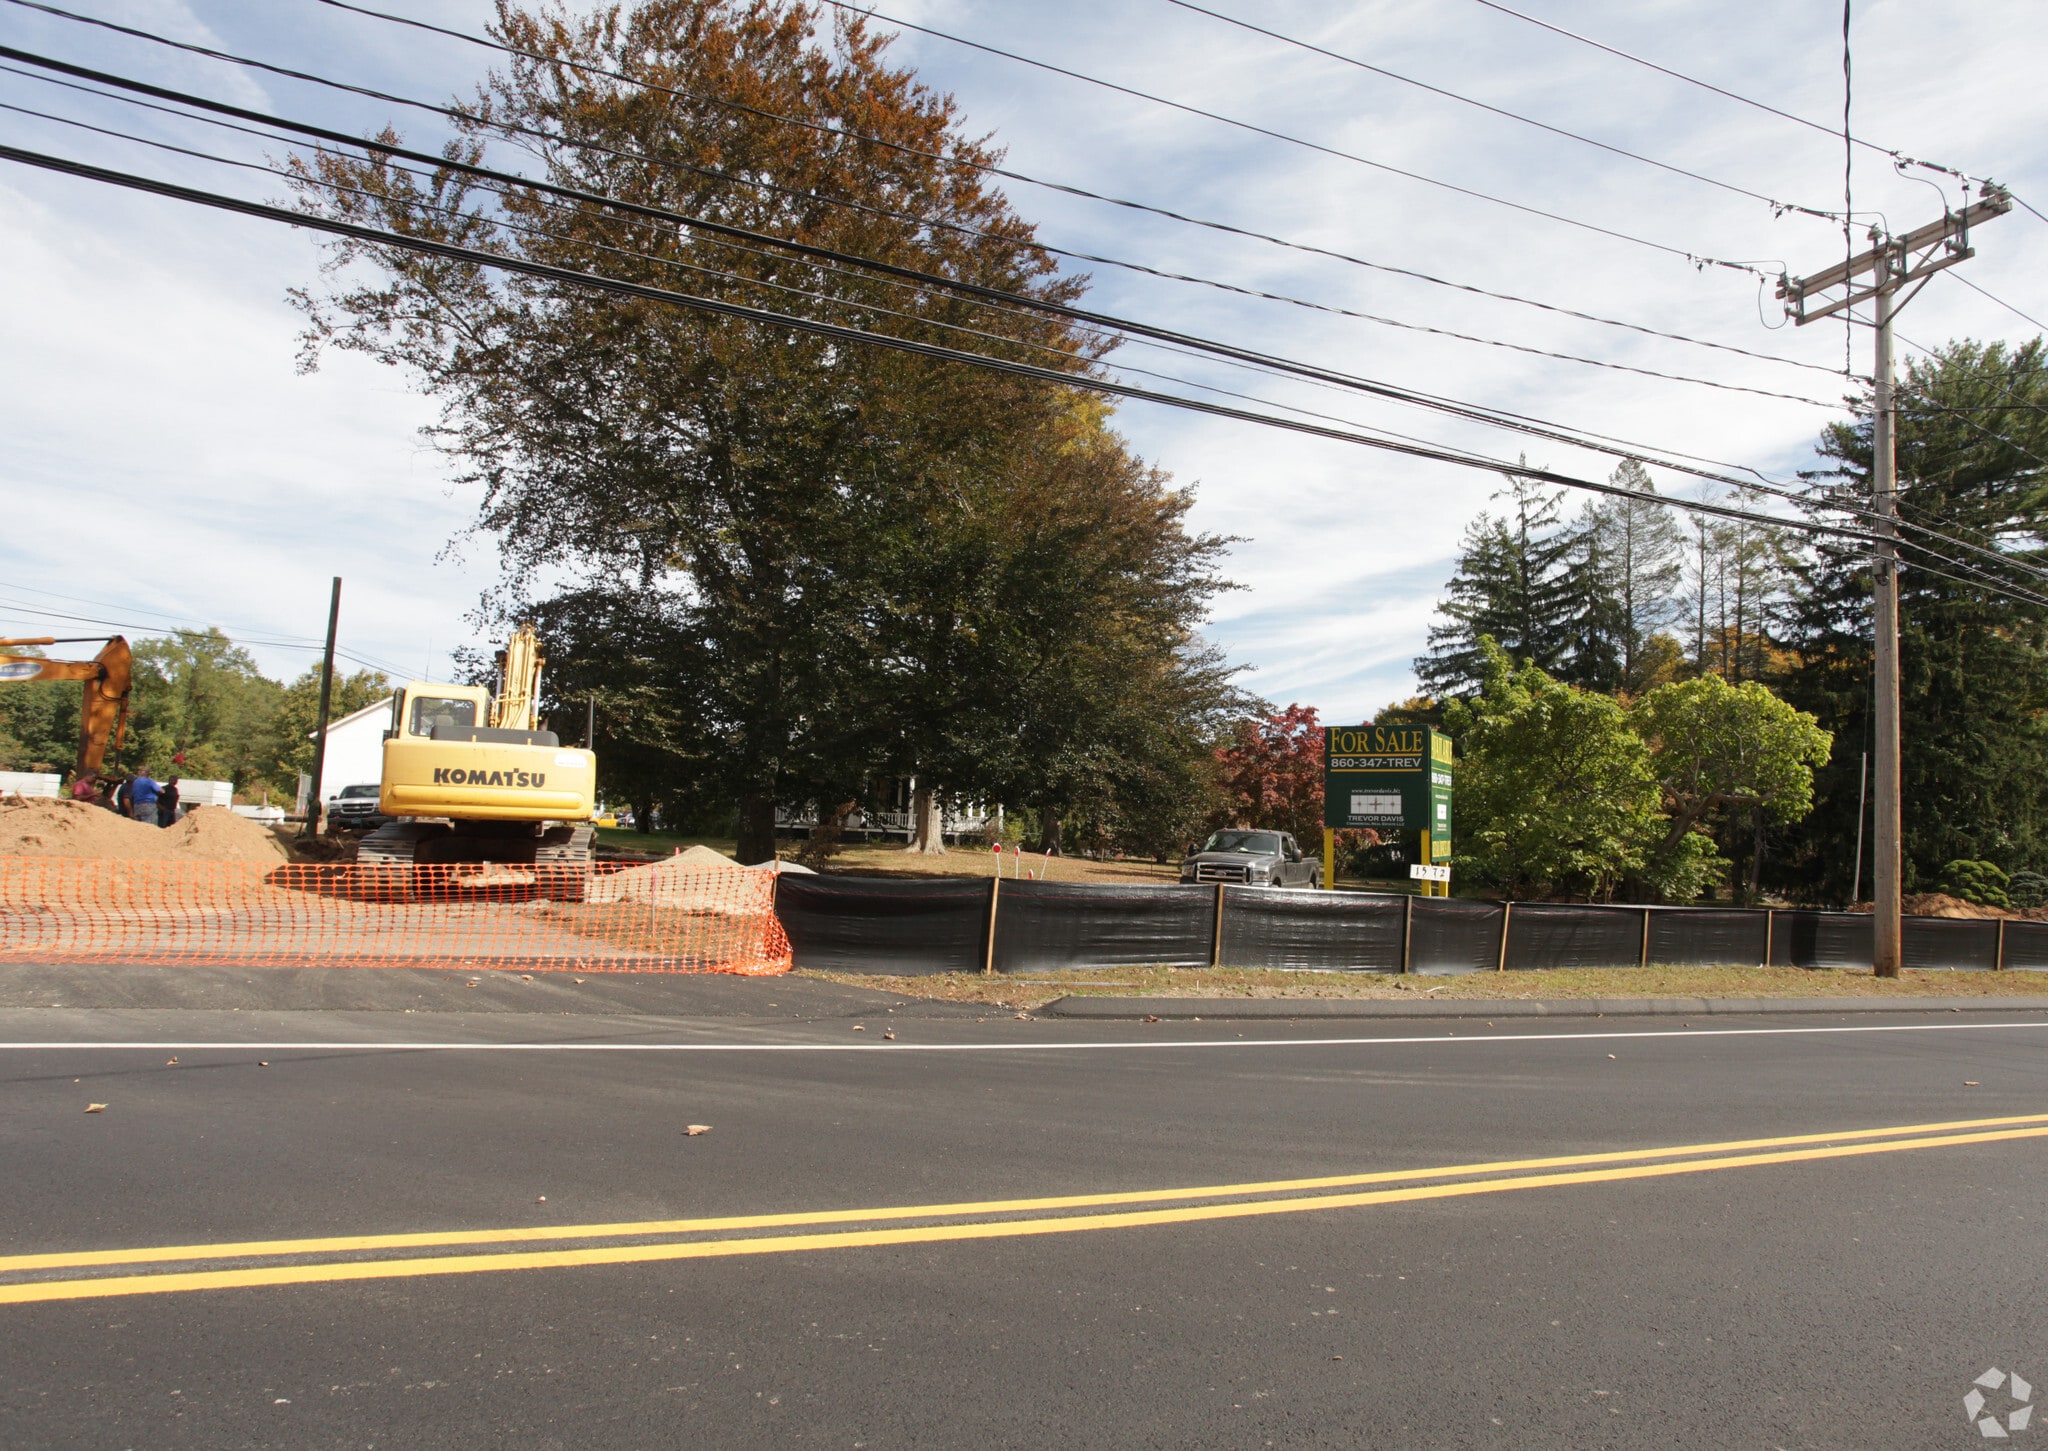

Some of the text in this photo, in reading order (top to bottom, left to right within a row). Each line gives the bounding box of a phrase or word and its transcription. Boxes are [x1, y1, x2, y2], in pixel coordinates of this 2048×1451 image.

[1330, 727, 1370, 753] FOR
[1375, 726, 1424, 753] SALE
[1331, 758, 1421, 768] 860-347-TREV
[434, 767, 545, 788] KOMATSU
